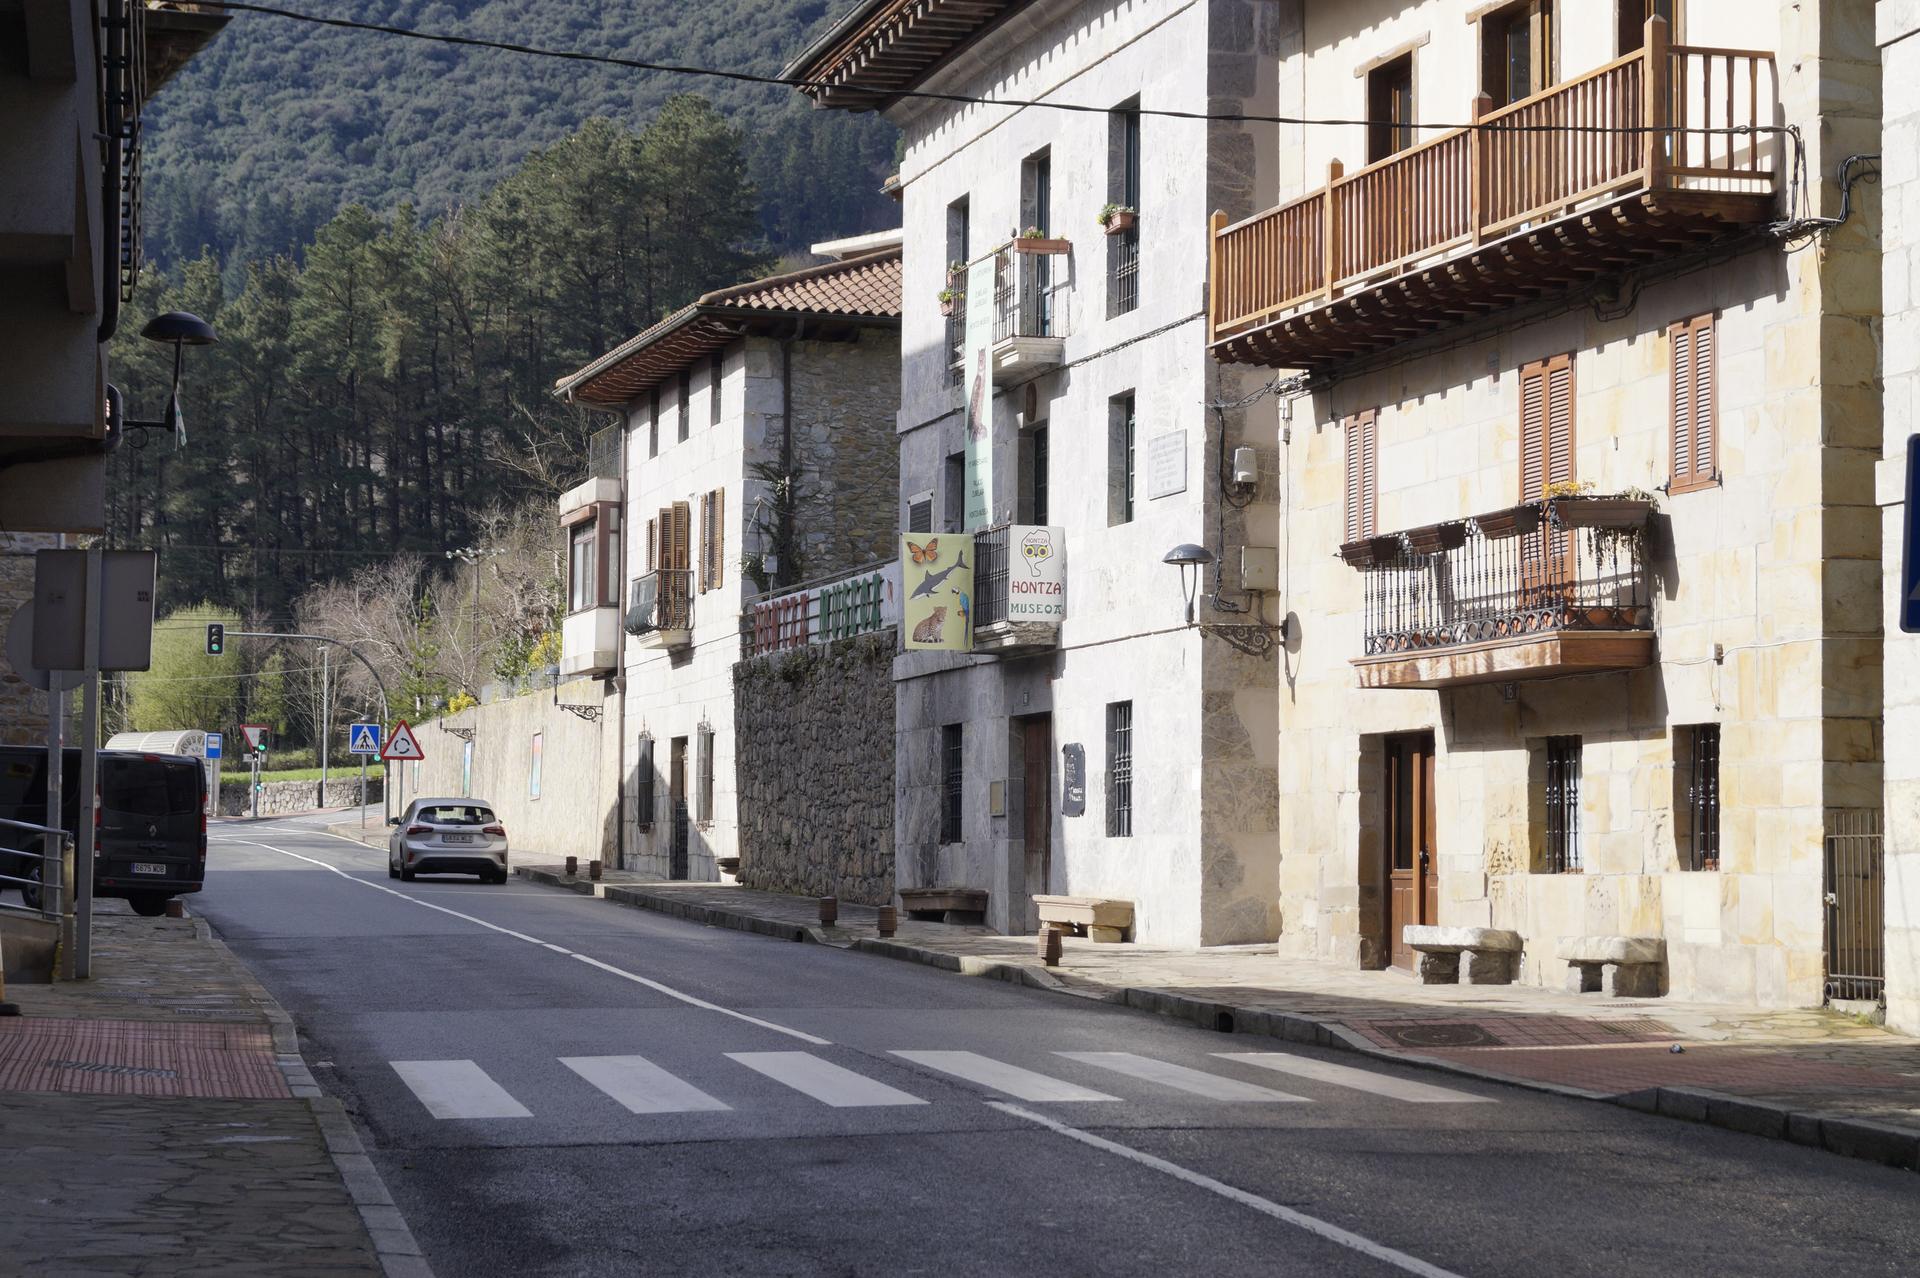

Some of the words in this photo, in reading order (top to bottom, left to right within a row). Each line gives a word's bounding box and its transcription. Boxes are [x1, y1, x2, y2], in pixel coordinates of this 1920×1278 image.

[1011, 581, 1062, 595] HONTZA
[755, 593, 808, 655] HONTZA
[819, 573, 881, 641] MUSEOA
[1010, 603, 1062, 615] MUSEOA
